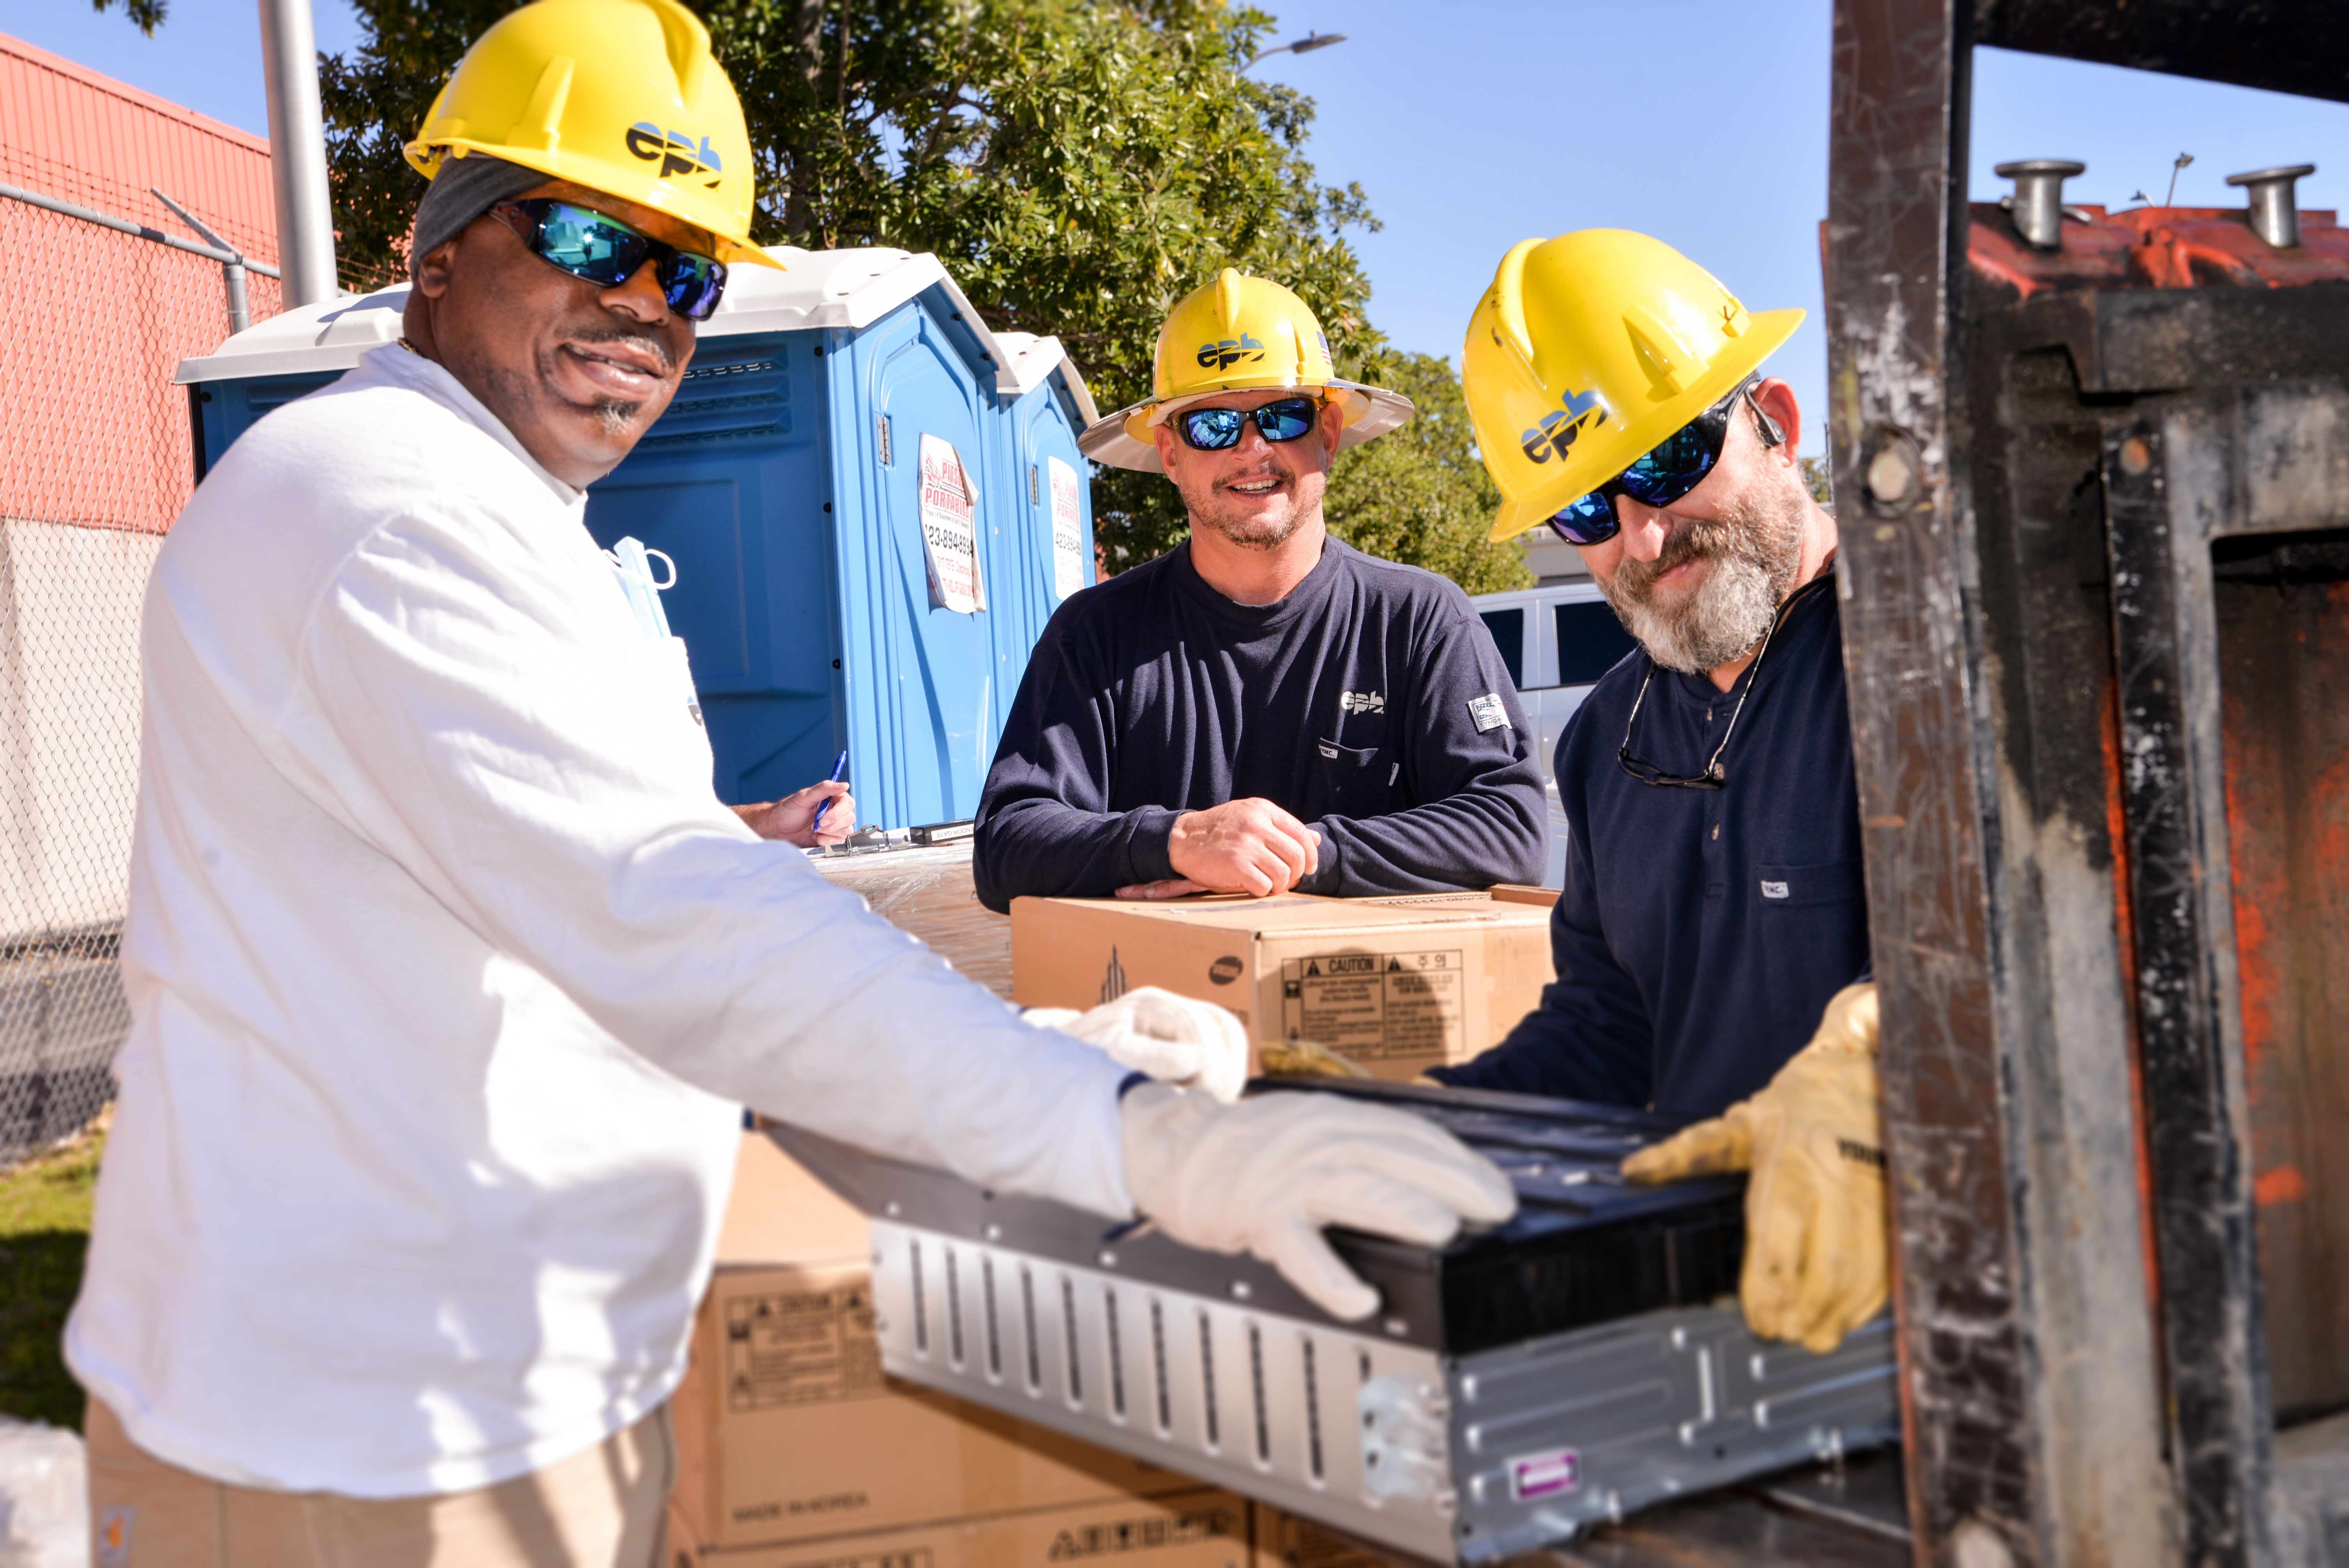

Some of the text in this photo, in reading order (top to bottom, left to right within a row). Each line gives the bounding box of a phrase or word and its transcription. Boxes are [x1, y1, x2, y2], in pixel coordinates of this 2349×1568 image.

[1197, 332, 1265, 372] epb
[925, 488, 969, 518] PORTABLES
[1341, 691, 1383, 715] epb
[1329, 957, 1374, 973] CAUTION
